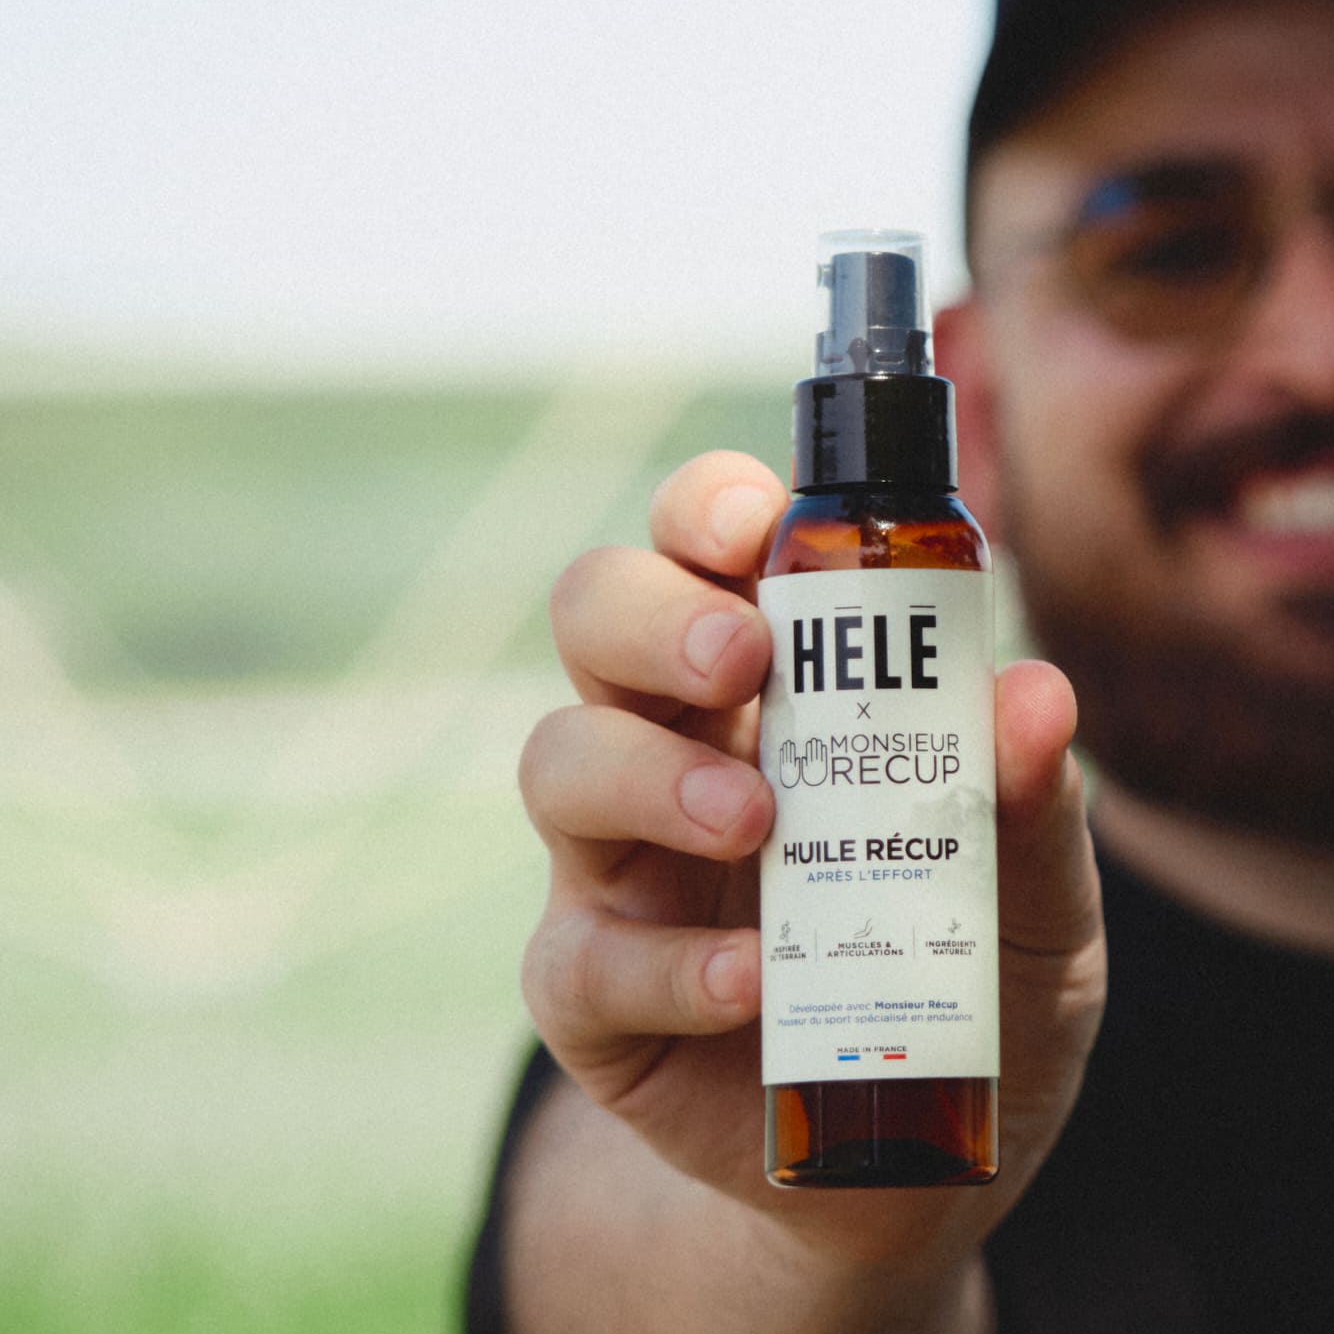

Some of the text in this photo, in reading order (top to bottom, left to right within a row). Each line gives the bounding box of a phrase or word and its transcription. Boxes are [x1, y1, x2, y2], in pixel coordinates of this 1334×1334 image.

[831, 733, 960, 753] MONSIEUR
[831, 754, 960, 785] RECUP
[784, 832, 959, 865] HUILE RÉCUP
[807, 868, 933, 883] APRÈS L'EFFORT
[925, 940, 976, 948] INGRÉDIENTS
[827, 949, 904, 958] ARTICULATIONS
[932, 948, 972, 956] NATURELS
[789, 999, 958, 1014] Développée avec Monsieur Récup
[810, 1016, 822, 1025] du
[825, 1015, 851, 1026] sport
[856, 1013, 908, 1024] spécialisé
[911, 1014, 924, 1022] en
[927, 1013, 973, 1021] endurance
